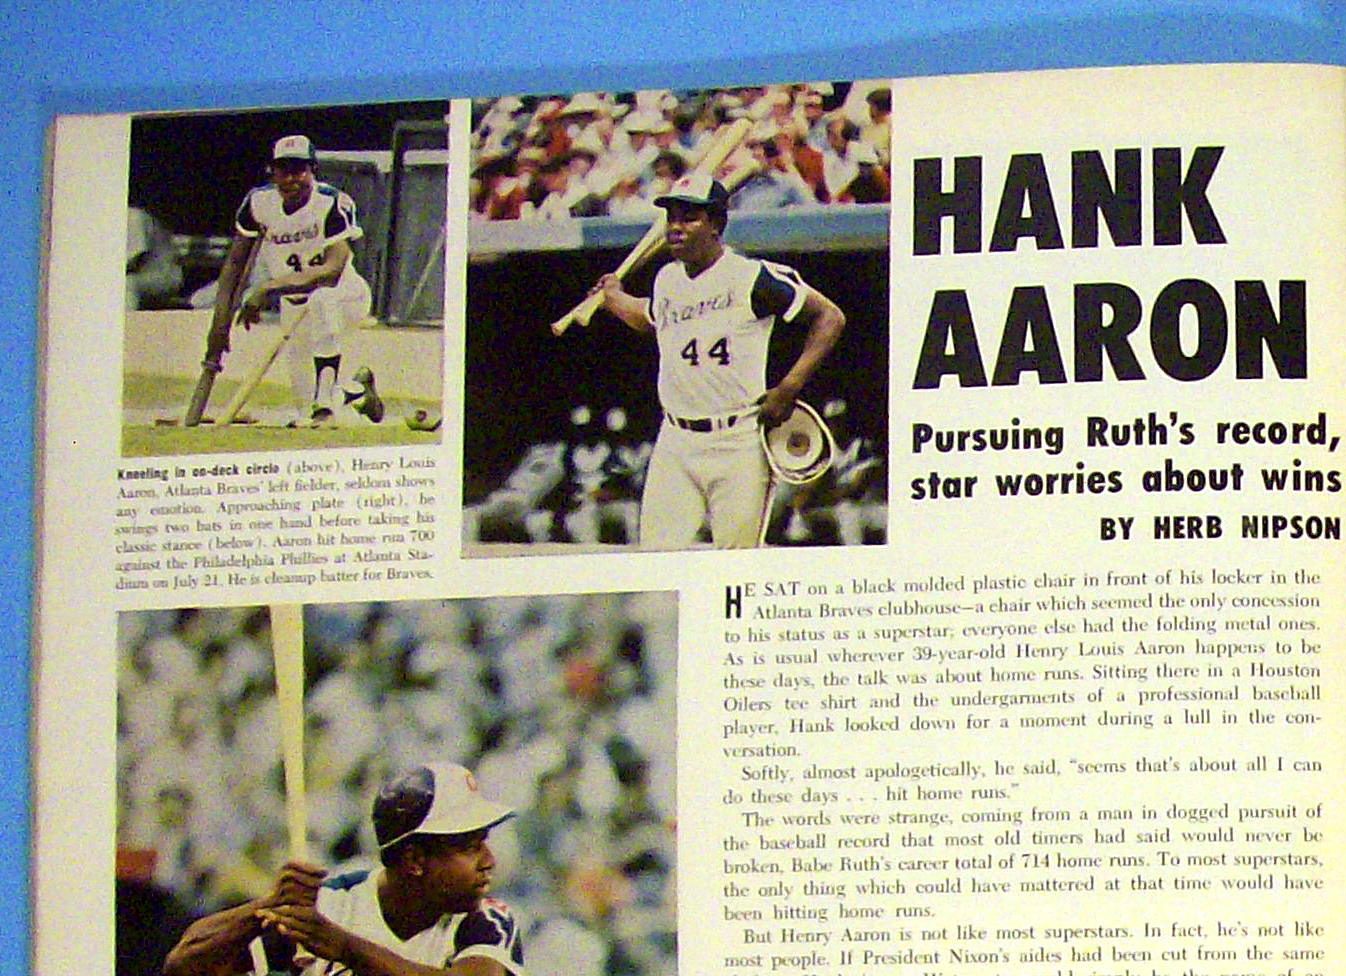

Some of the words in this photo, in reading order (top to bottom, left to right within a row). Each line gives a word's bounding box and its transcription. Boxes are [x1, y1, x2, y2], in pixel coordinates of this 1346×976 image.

[912, 146, 1227, 256] HANK
[912, 278, 1309, 390] AARON
[681, 337, 730, 366] 44
[912, 419, 1064, 455] Pursuing
[1087, 412, 1195, 448] Ruth's
[1216, 412, 1341, 453] record,
[116, 467, 170, 483] Kneeling
[174, 467, 187, 478] in
[191, 464, 240, 477] on-deck
[245, 462, 280, 476] circle
[351, 457, 394, 473] Henry
[399, 456, 436, 468] Louis
[911, 472, 978, 500] star
[996, 463, 1123, 496] worries
[1142, 459, 1244, 492] about
[1262, 460, 1342, 492] wins
[115, 508, 138, 519] any
[216, 497, 302, 515] Approaching
[311, 495, 345, 511] plate
[418, 492, 436, 504] he
[1100, 517, 1134, 541] BY
[1154, 516, 1223, 539] HERB
[1242, 515, 1342, 540] NIPSON
[763, 581, 801, 596] SAT
[807, 585, 828, 595] on
[834, 585, 845, 595] a
[851, 578, 896, 594] black
[903, 575, 966, 592] molded
[972, 574, 1027, 594] plastic
[1033, 572, 1076, 589] chair
[1083, 572, 1100, 587] in
[1106, 569, 1148, 586] front
[1154, 569, 1172, 585] of
[1179, 568, 1204, 585] his
[1211, 567, 1264, 585] locker
[1270, 570, 1287, 584] in
[1293, 568, 1321, 584] the
[722, 695, 772, 712] Oilers
[784, 698, 810, 710] tee
[820, 694, 857, 709] shirt
[869, 692, 901, 708] and
[912, 691, 940, 708] the
[950, 689, 1076, 709] undergarments
[1086, 687, 1103, 703] of
[1115, 692, 1126, 702] a
[1138, 684, 1239, 706] professional
[1252, 683, 1321, 702] baseball
[791, 857, 833, 872] Babe
[839, 855, 892, 872] Ruth's
[897, 860, 950, 871] career
[954, 853, 993, 870] total
[997, 853, 1016, 869] of
[1020, 853, 1050, 868] 714
[1056, 852, 1103, 868] home
[1156, 851, 1181, 867] To
[1186, 853, 1227, 866] most
[724, 955, 763, 967] most
[839, 950, 853, 965] If
[862, 948, 941, 965] President
[949, 948, 1010, 964] Nixon's
[1019, 946, 1063, 963] aides
[1070, 946, 1103, 962] had
[1111, 945, 1152, 962] been
[1160, 948, 1188, 961] cut
[1196, 944, 1238, 961] from
[1246, 945, 1274, 960] the
[1282, 950, 1325, 960] same
